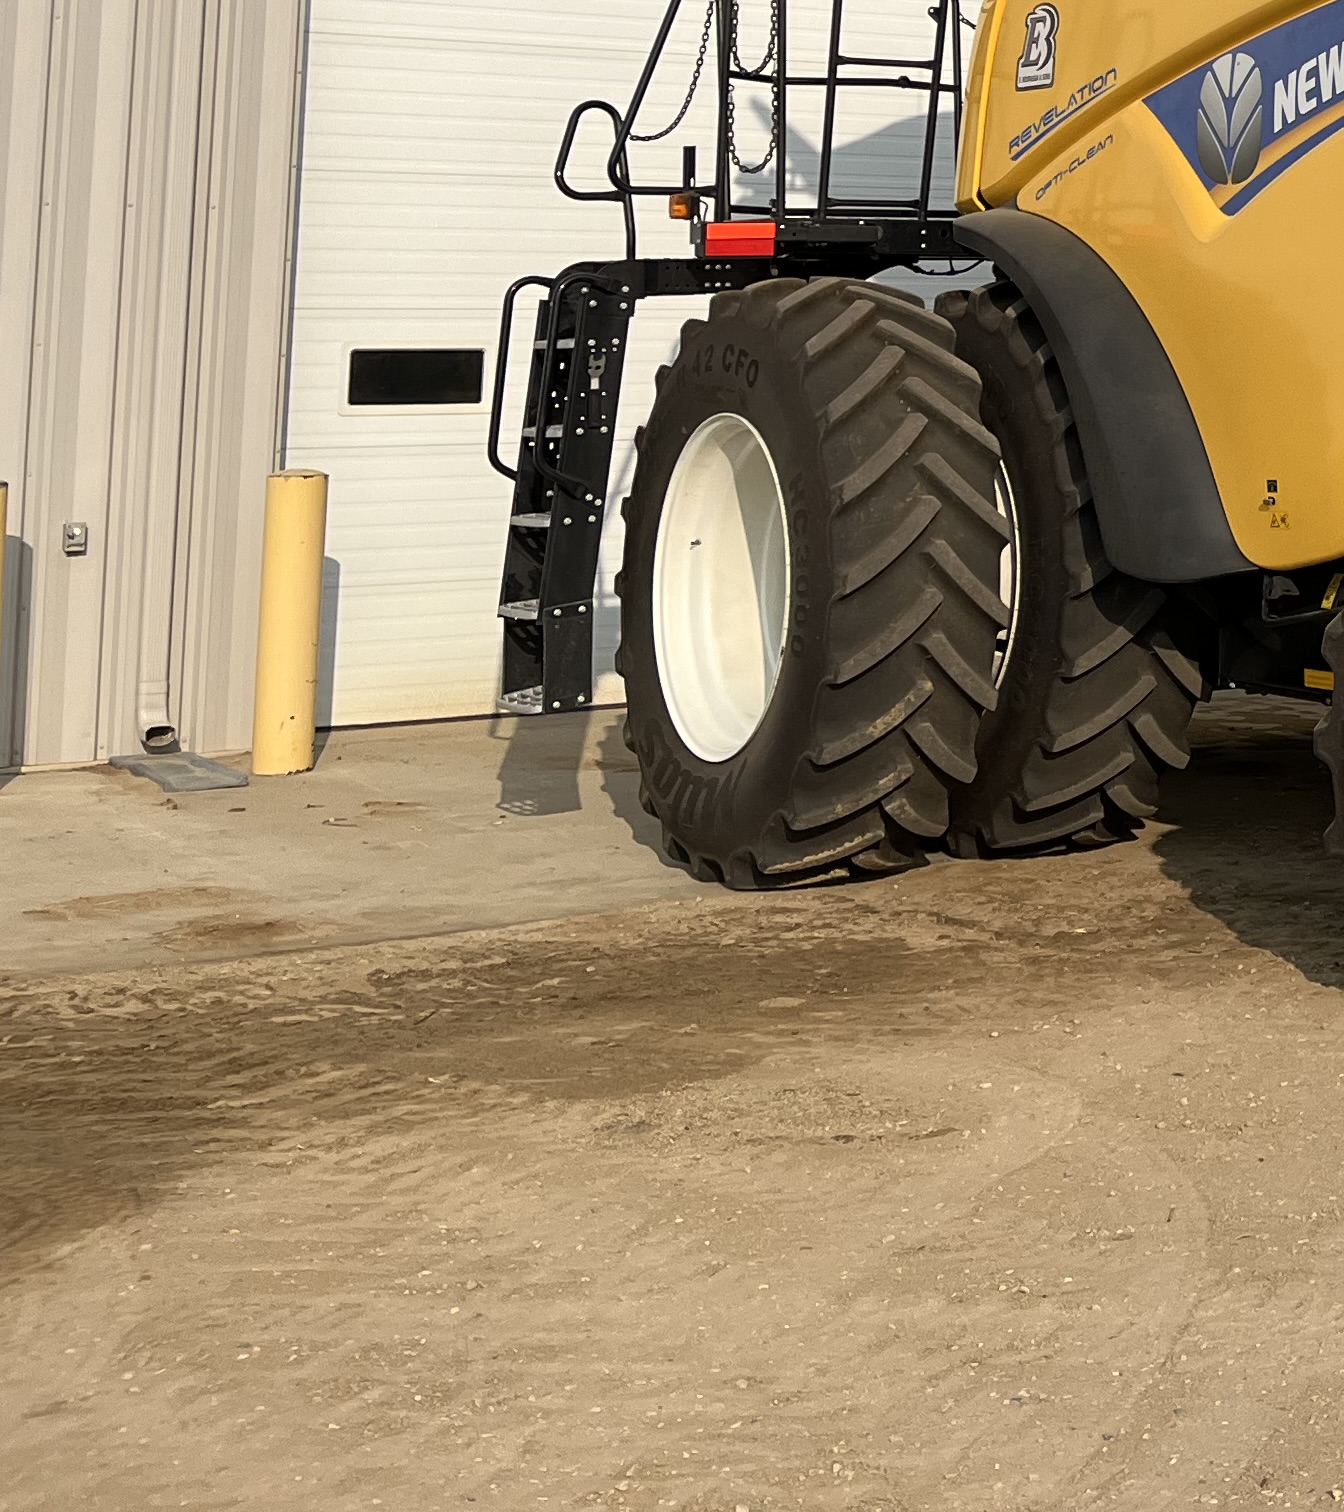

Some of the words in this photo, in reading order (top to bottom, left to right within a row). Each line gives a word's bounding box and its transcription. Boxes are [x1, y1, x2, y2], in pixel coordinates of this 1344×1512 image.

[1008, 67, 1117, 155] REVELATION
[1035, 134, 1114, 202] OPTI-CLEAN
[722, 343, 759, 389] CFO
